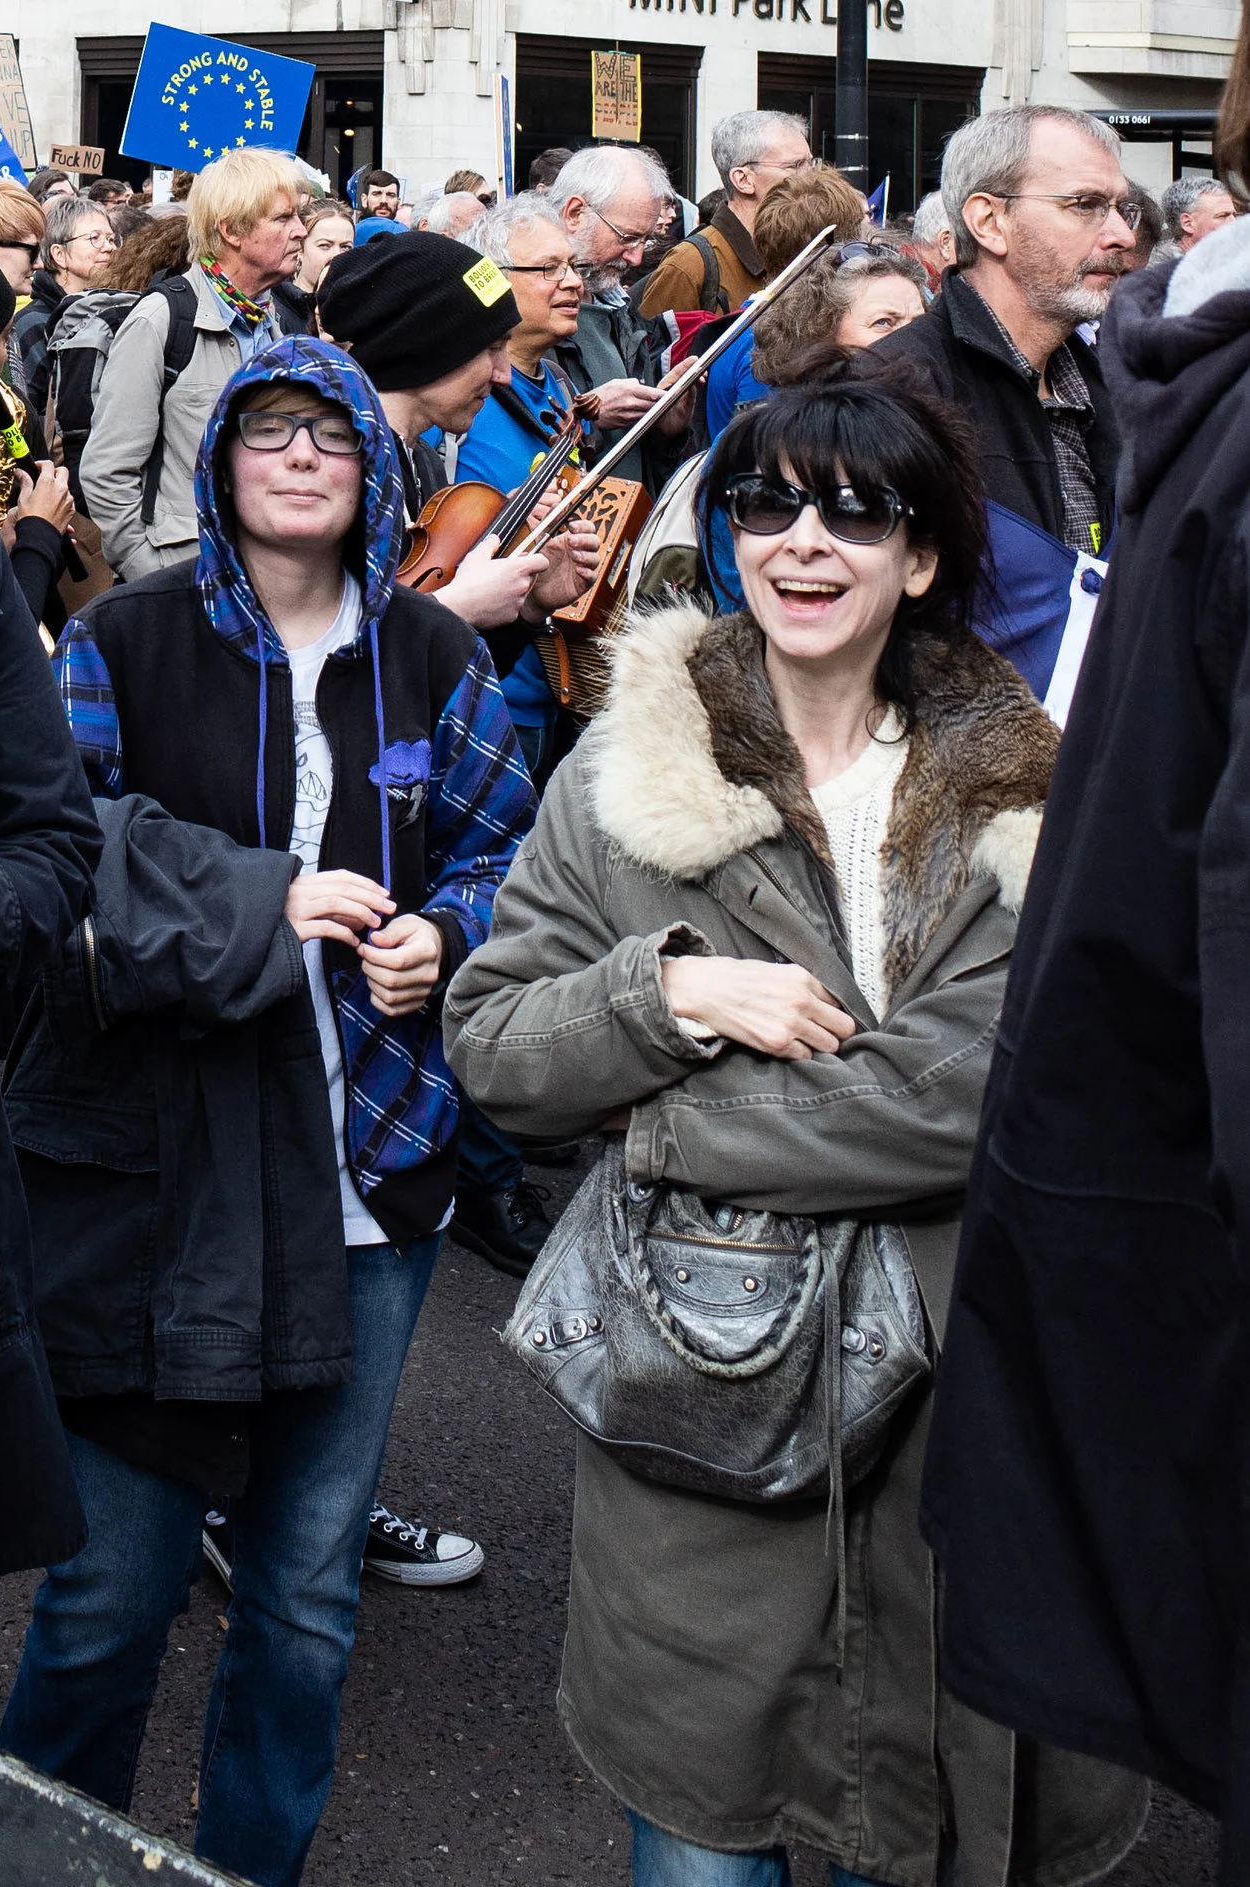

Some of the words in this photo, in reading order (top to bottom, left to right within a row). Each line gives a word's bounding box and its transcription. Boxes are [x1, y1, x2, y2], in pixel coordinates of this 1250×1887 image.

[595, 52, 637, 83] WE
[161, 51, 213, 106] STRONG
[216, 50, 250, 72] AND
[248, 68, 275, 132] STABLE
[595, 80, 617, 99] ARE
[619, 81, 639, 103] THE
[1108, 115, 1130, 125] 0133
[1131, 115, 1152, 125] 0661
[51, 147, 81, 168] Fuck
[84, 148, 102, 170] NO
